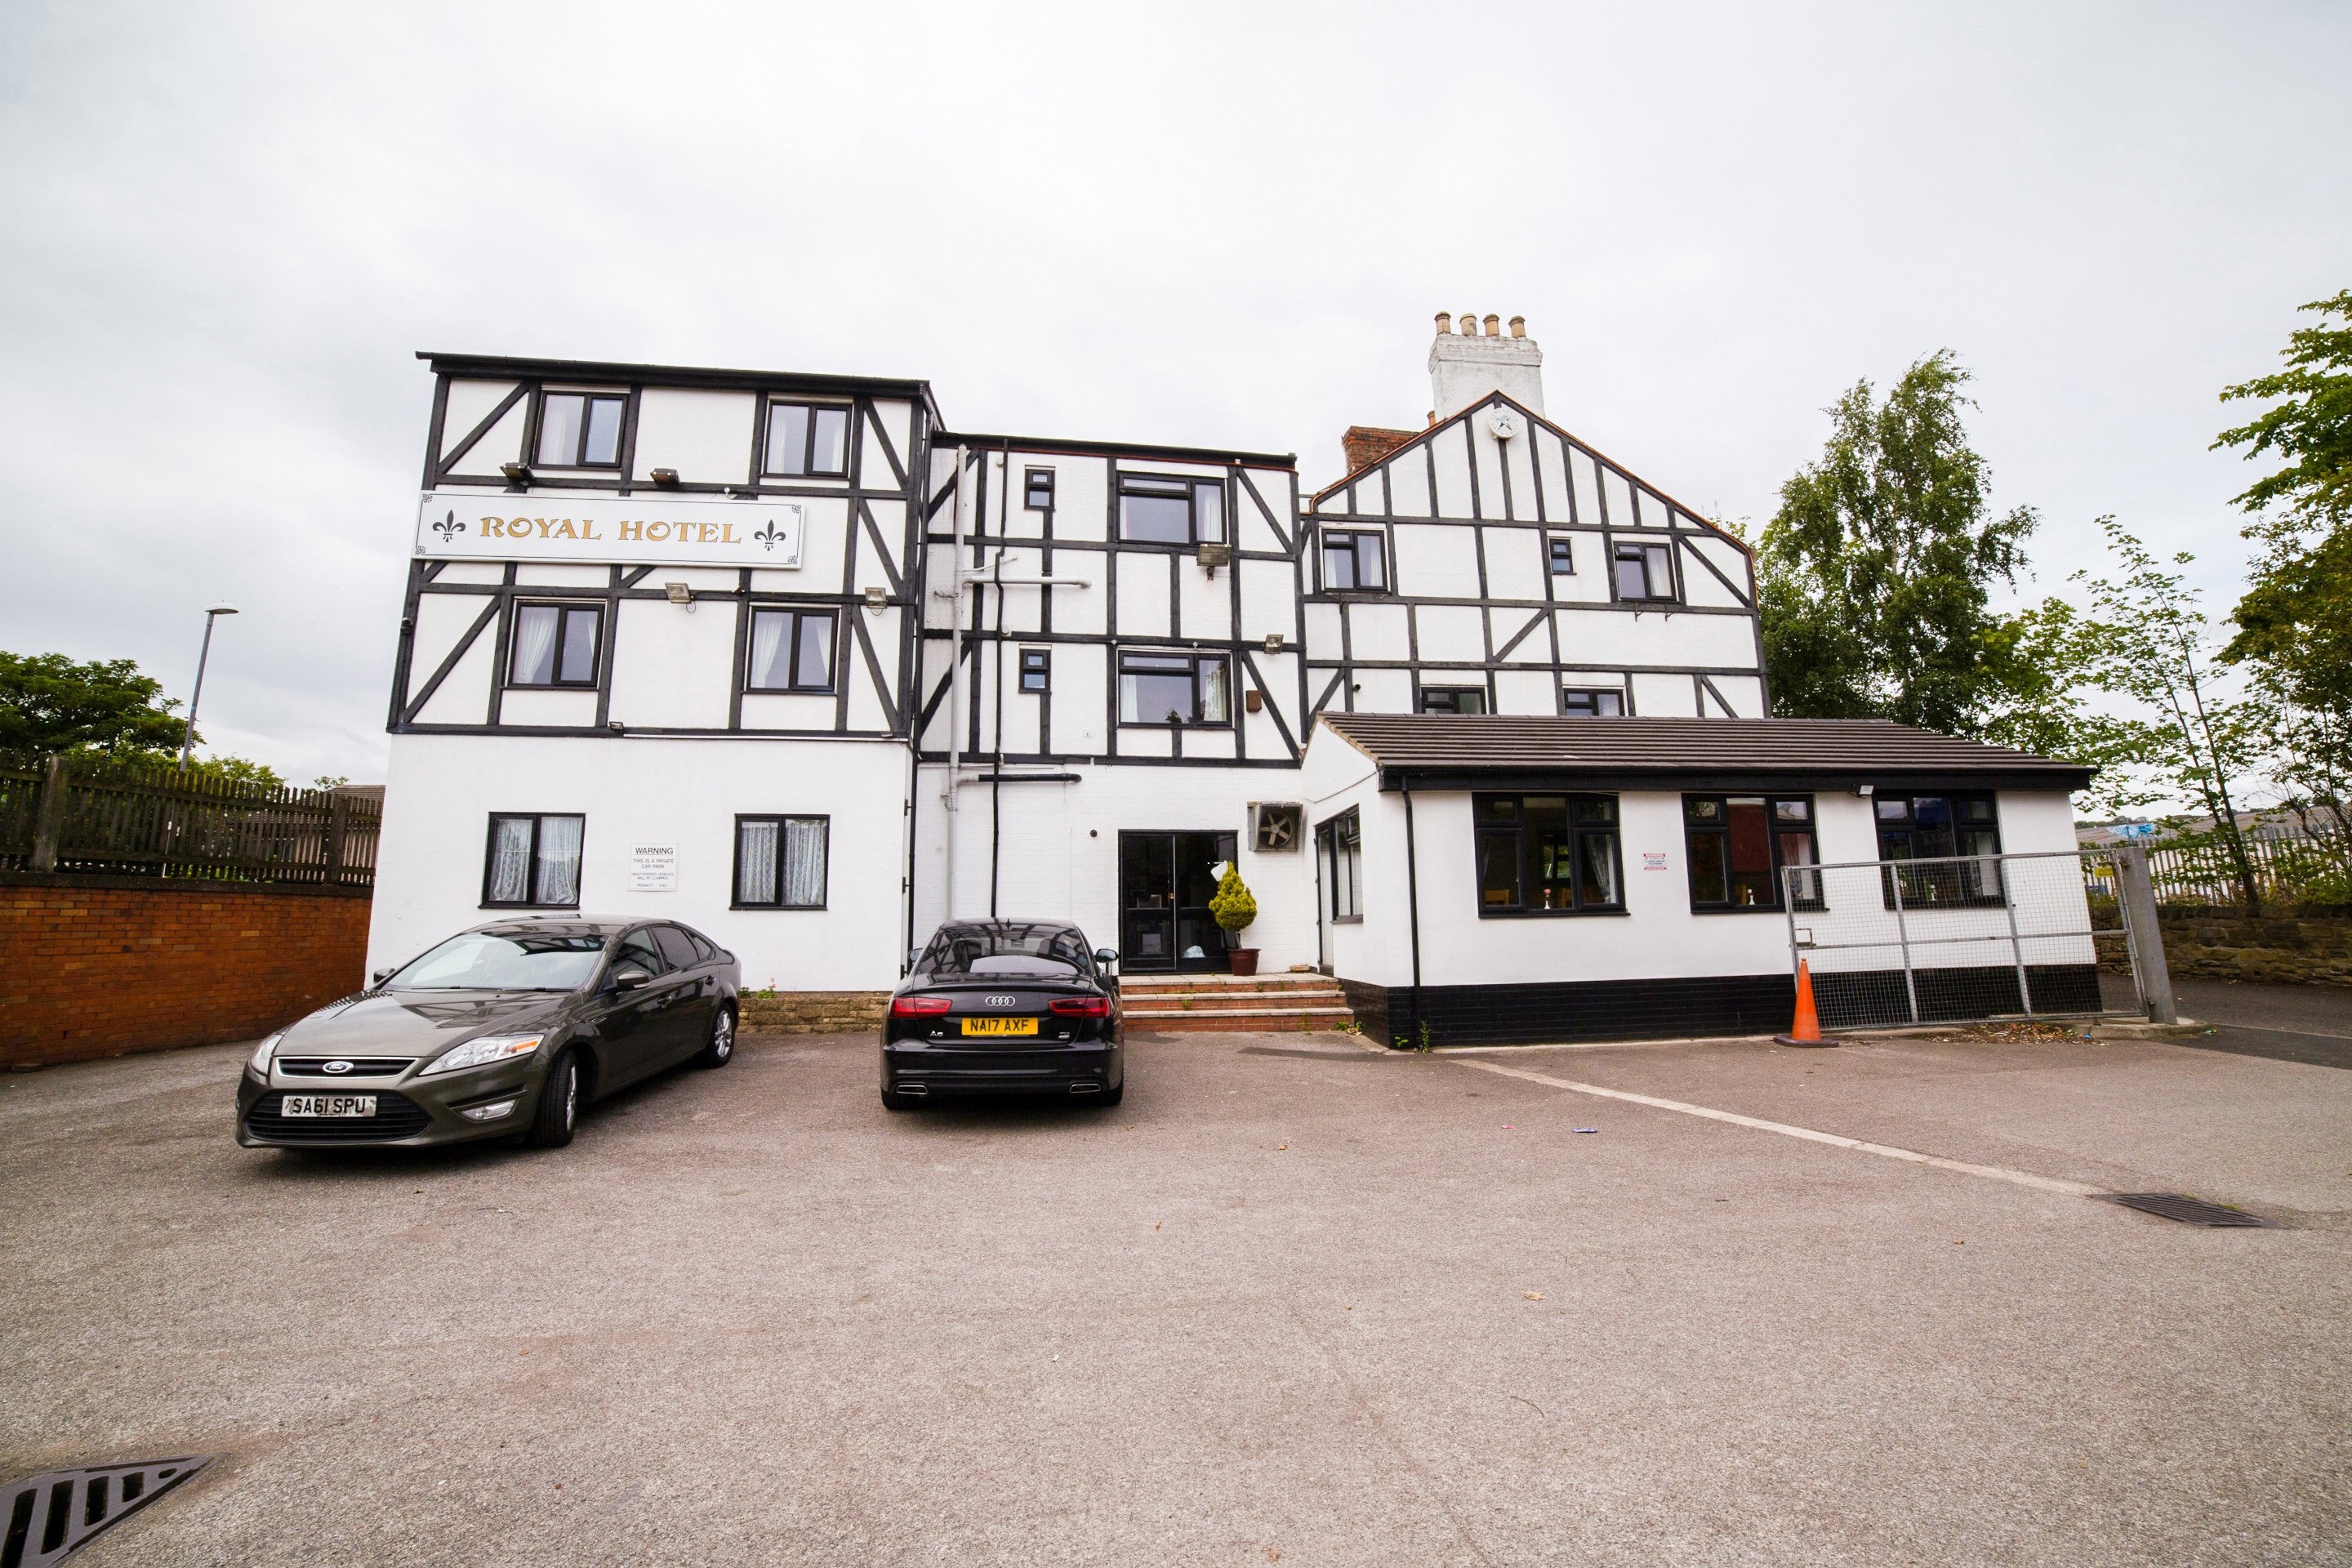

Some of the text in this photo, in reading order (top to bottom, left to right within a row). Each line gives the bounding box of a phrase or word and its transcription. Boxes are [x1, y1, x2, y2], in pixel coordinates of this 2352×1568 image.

[479, 516, 742, 544] ROYAL HOTEL
[970, 1019, 1029, 1031] NA17 AXF
[293, 1098, 365, 1113] SA61 SPU
